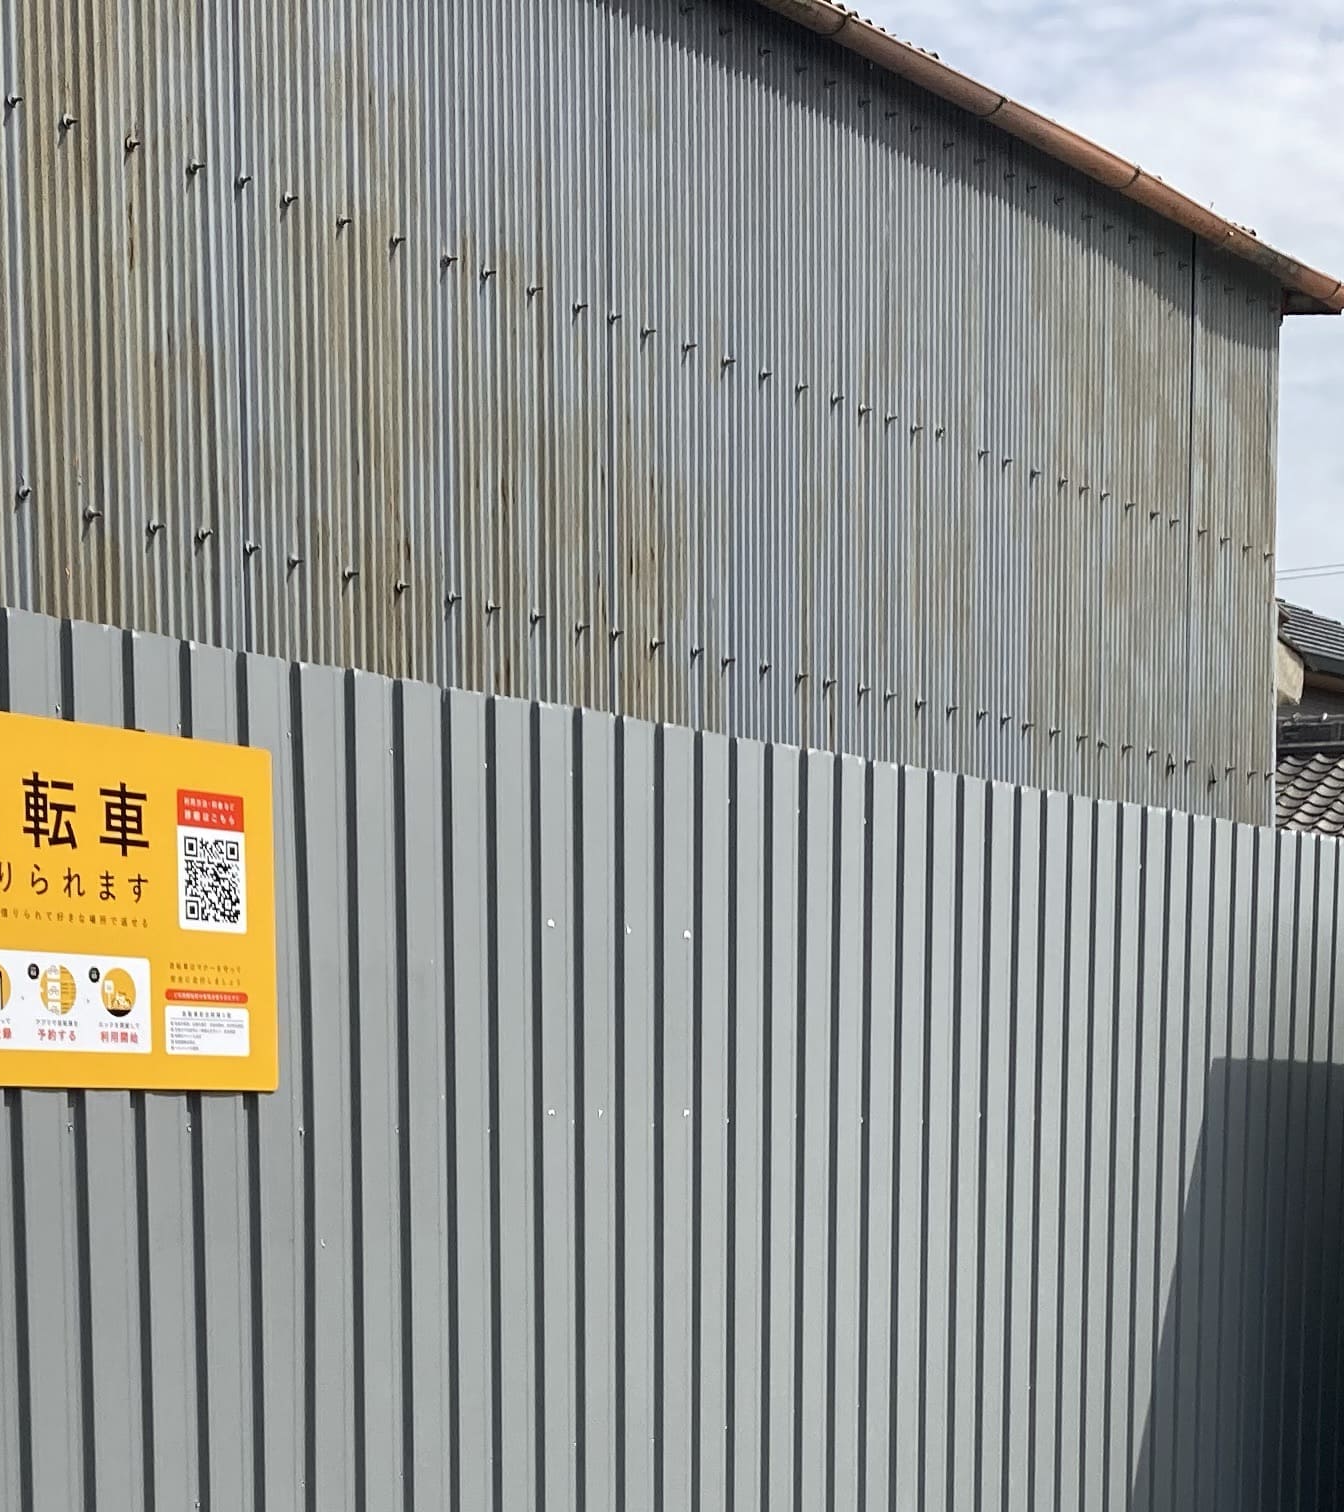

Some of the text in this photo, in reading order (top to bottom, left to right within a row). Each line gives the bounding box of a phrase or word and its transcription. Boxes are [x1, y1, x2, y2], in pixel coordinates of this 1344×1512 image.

[37, 1028, 77, 1041] 予約する
[100, 1031, 139, 1044] 利用開始
